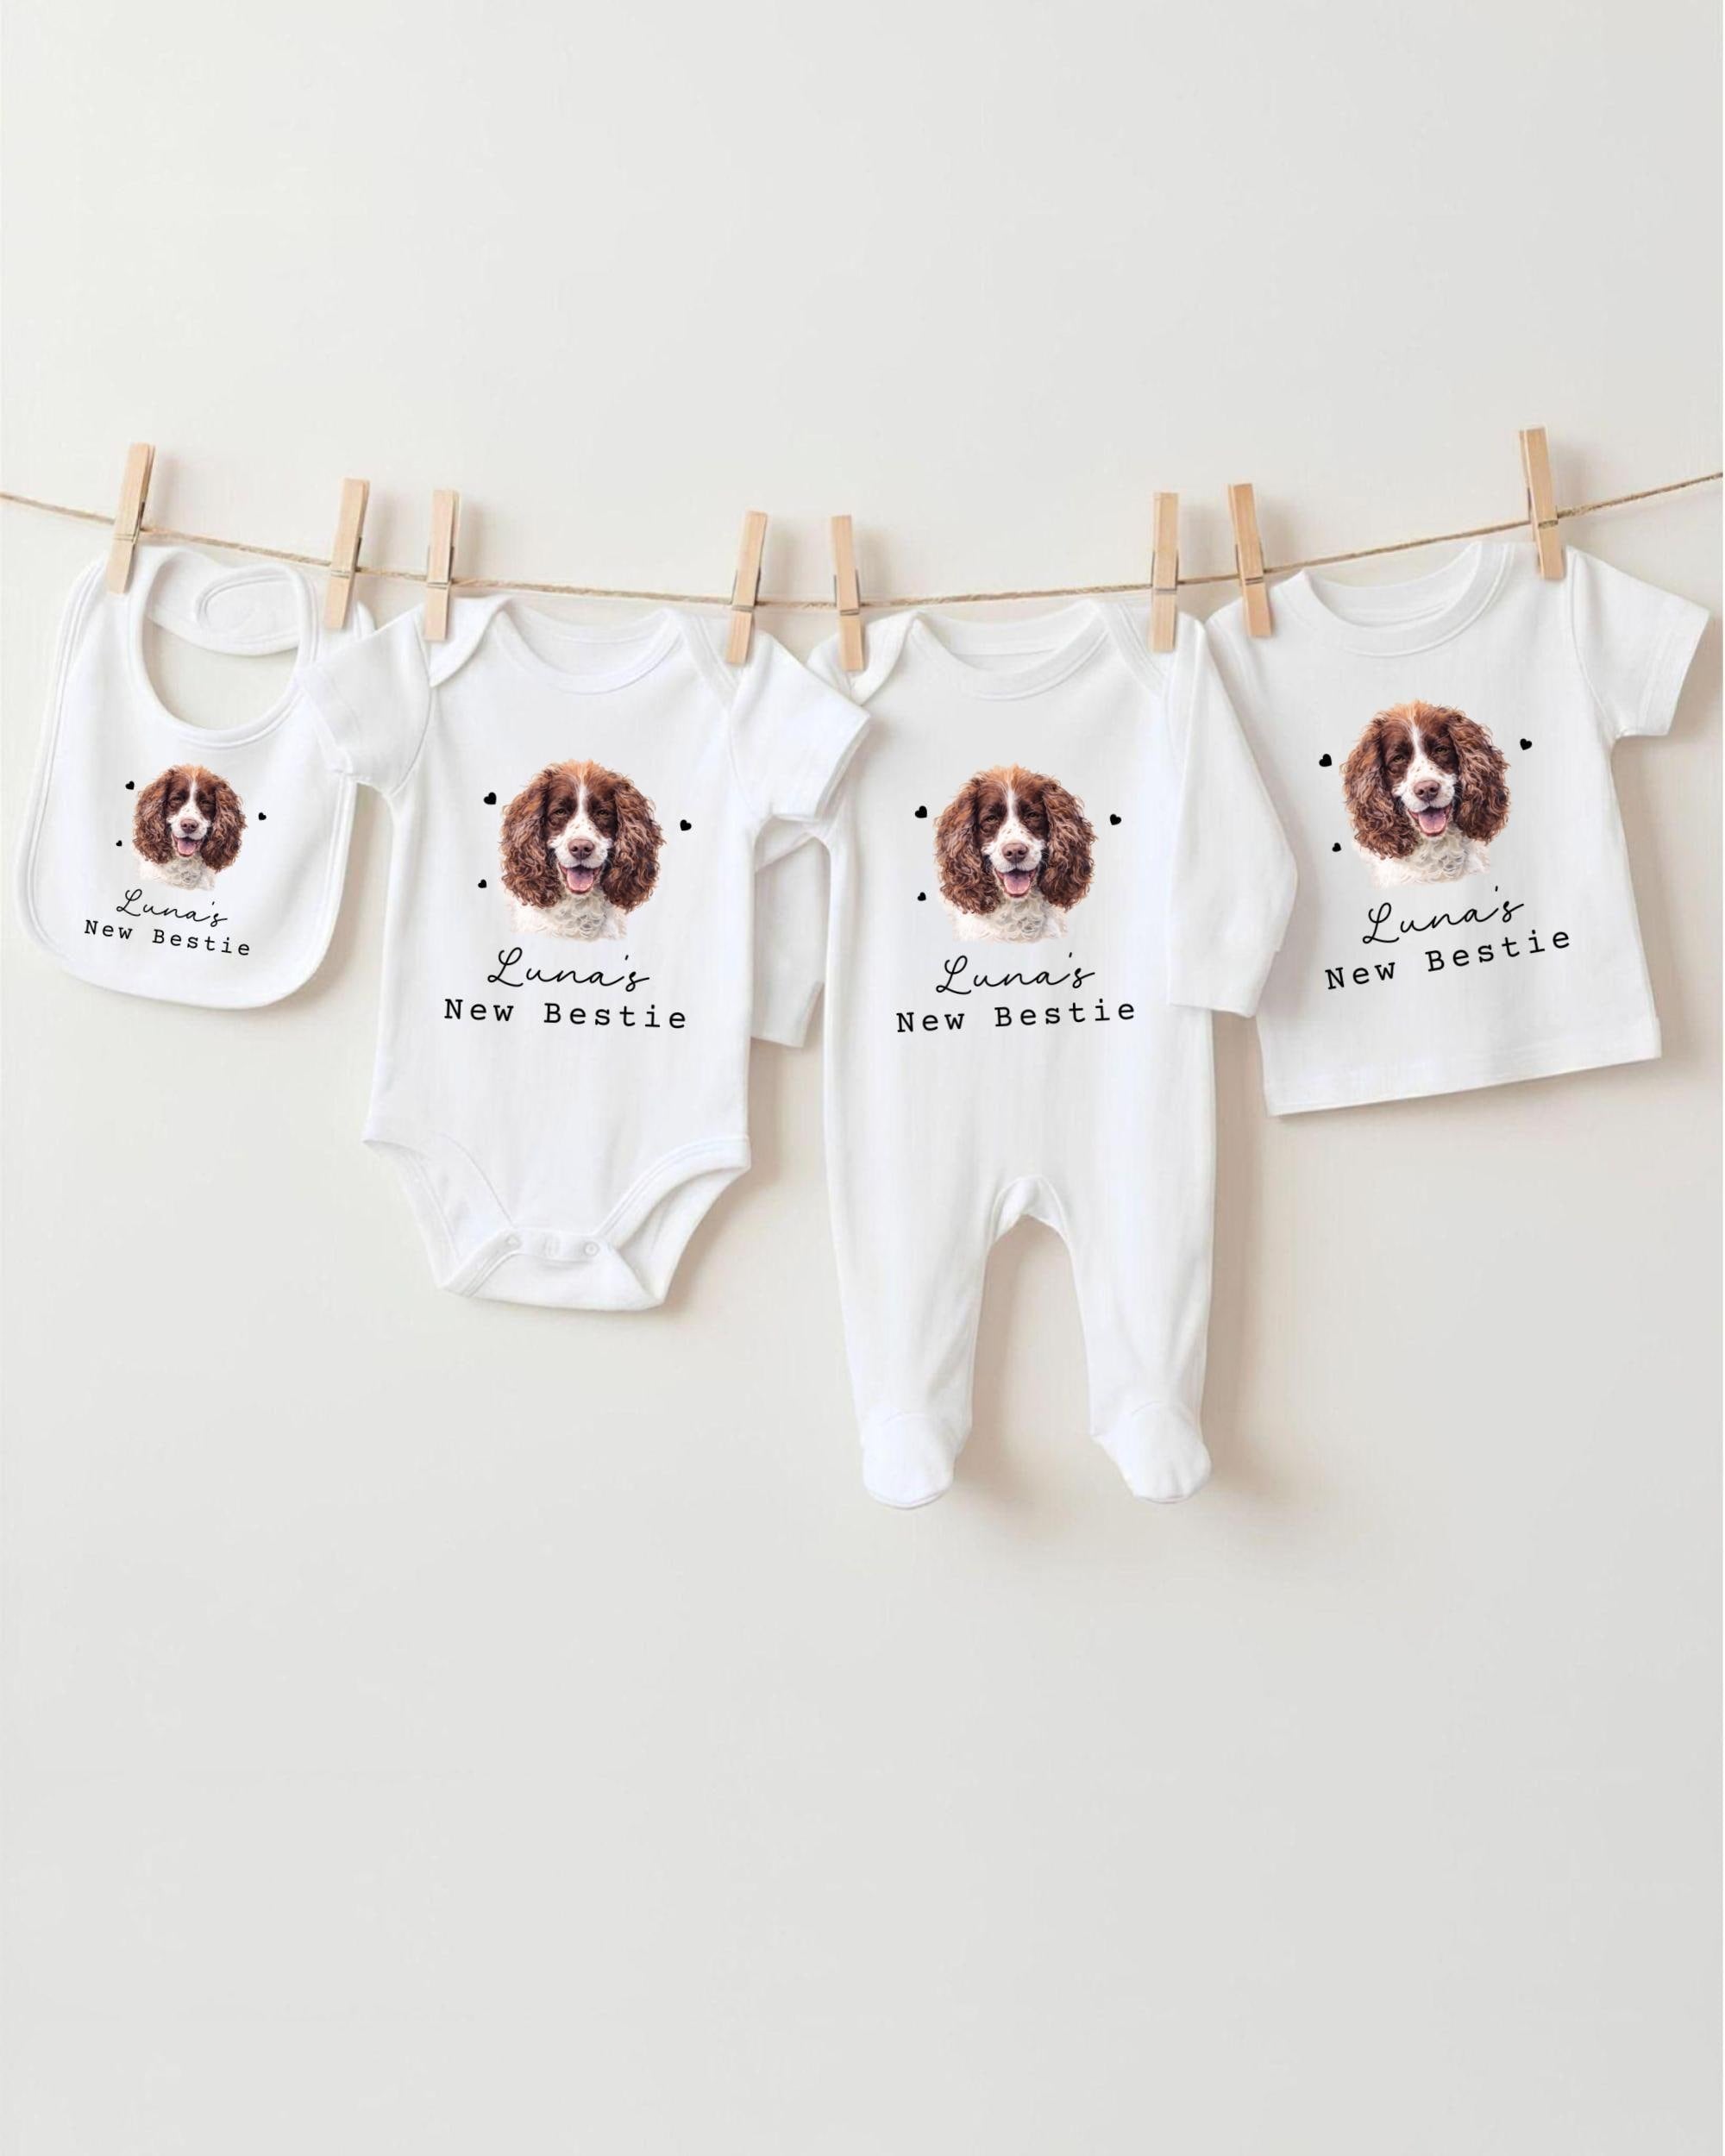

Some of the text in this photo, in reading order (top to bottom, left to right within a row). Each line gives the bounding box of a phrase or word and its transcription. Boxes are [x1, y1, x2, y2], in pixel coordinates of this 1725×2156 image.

[116, 888, 229, 929] Luna's
[1361, 885, 1525, 944] Luna's
[84, 919, 250, 956] New Bestie
[486, 946, 650, 993] Luna's
[935, 951, 1096, 995] Luna's
[1324, 929, 1570, 990] New Bestie
[443, 998, 686, 1029] New Bestie
[895, 998, 1135, 1033] New Bestie
